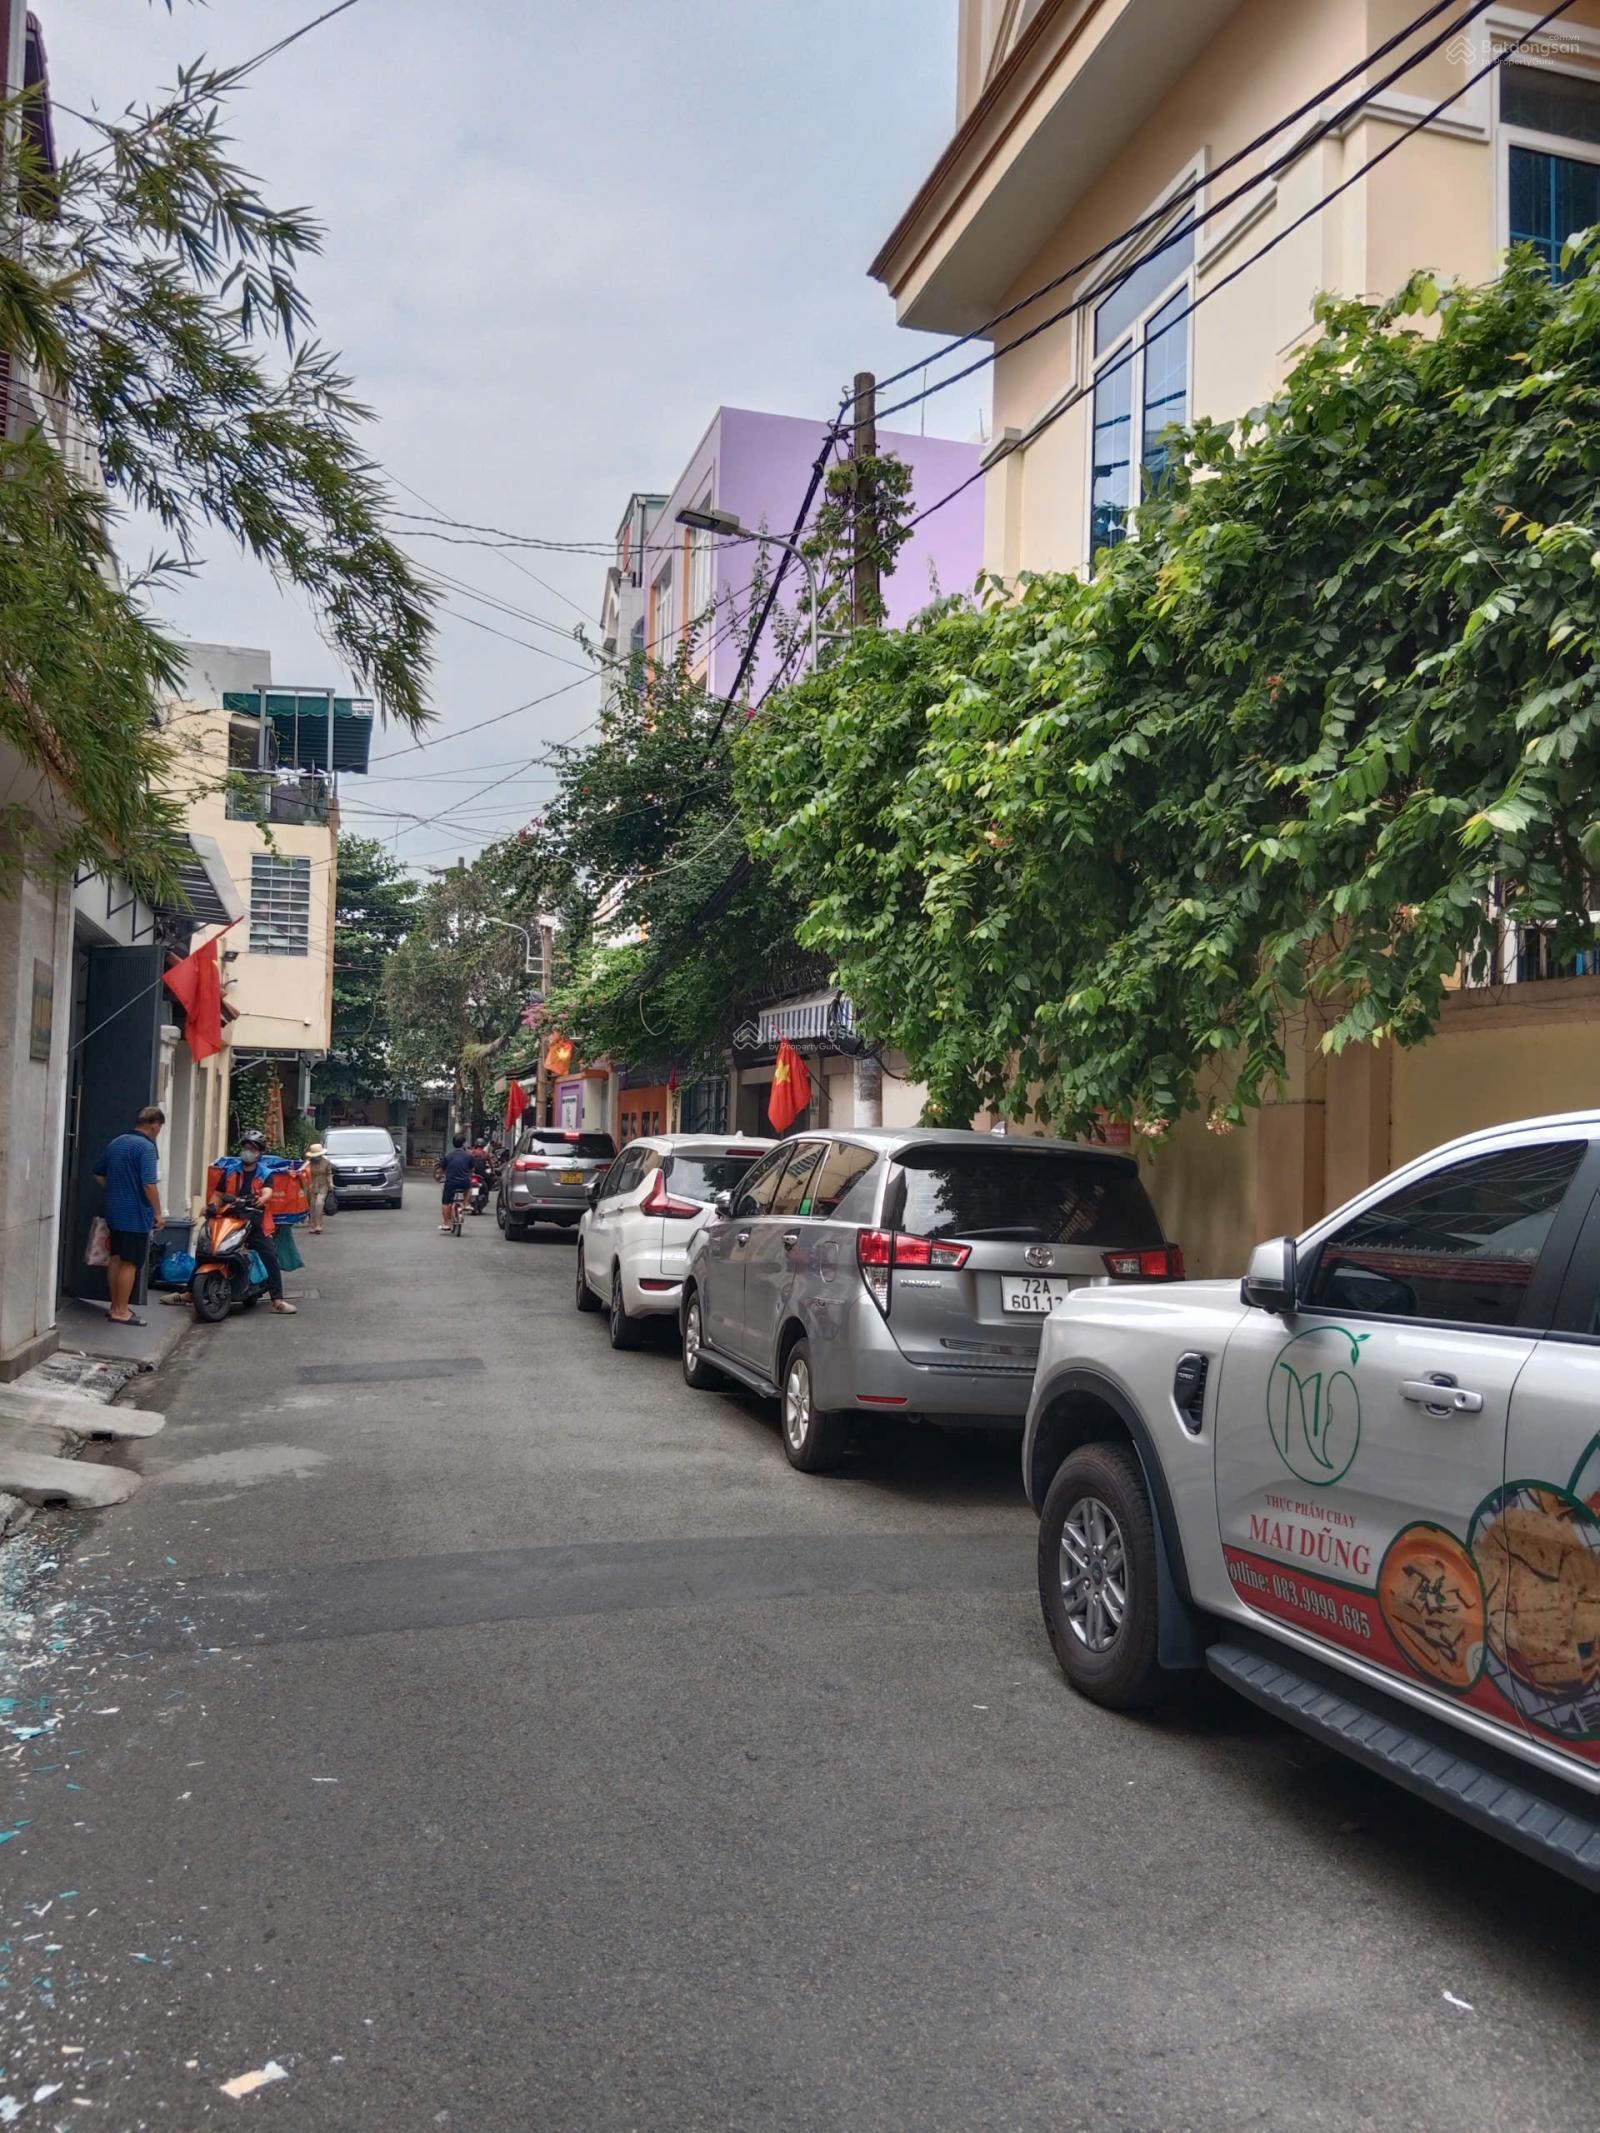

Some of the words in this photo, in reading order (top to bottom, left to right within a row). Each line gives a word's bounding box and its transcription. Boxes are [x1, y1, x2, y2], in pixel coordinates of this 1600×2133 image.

[1022, 1279, 1051, 1294] 72A
[1326, 1509, 1357, 1529] CHAY
[1248, 1514, 1296, 1553] MAI
[1300, 1527, 1370, 1575] DŨNG
[1225, 1556, 1271, 1594] otline:
[1272, 1573, 1371, 1640] 083.9999.685
